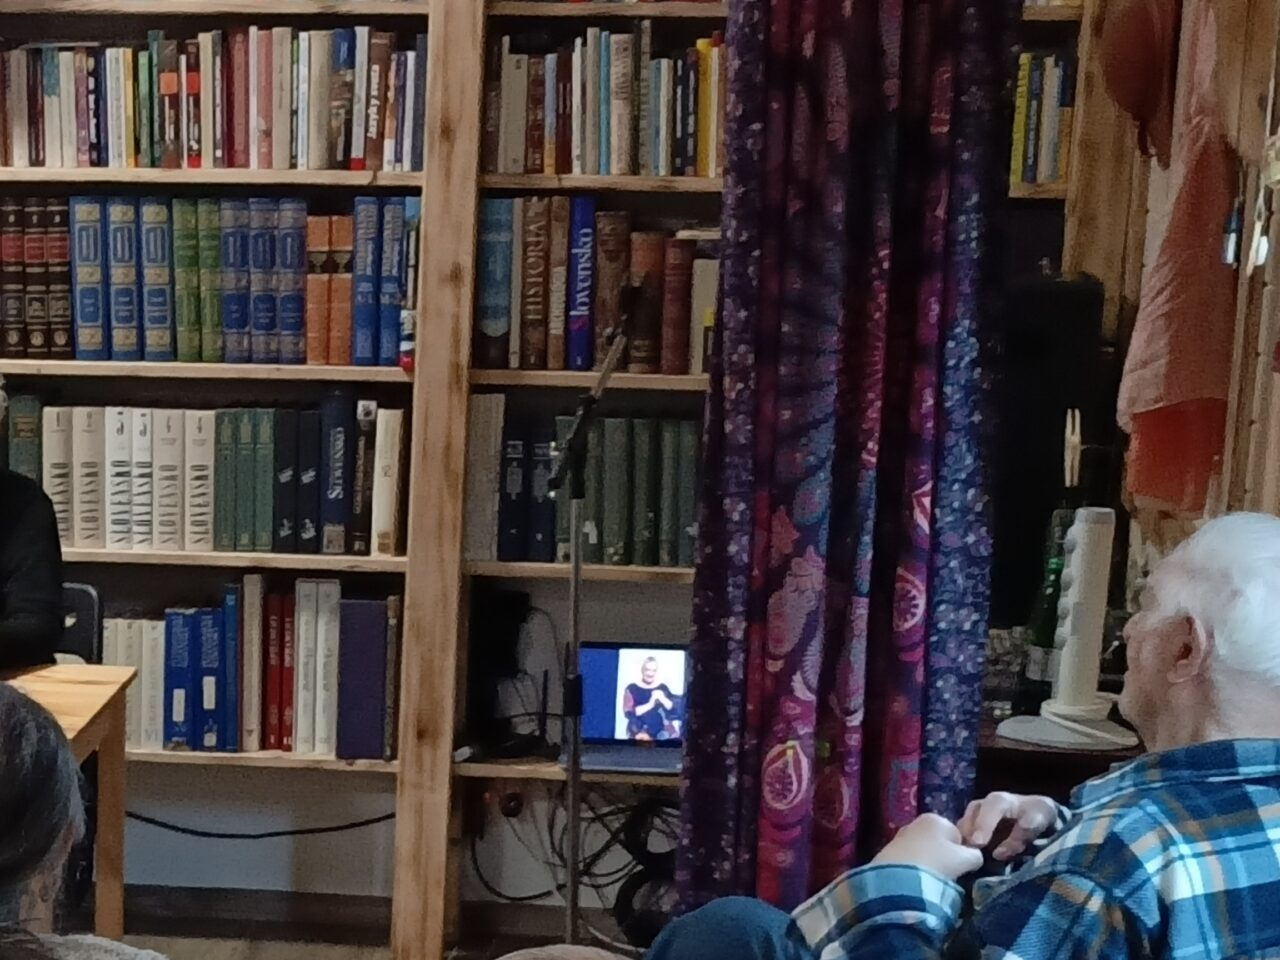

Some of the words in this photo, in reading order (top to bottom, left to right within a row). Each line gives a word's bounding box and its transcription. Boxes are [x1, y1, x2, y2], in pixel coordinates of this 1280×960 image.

[523, 220, 547, 321] HISTORIA
[110, 460, 132, 545] SLOVENSKO
[189, 464, 210, 545] SLOVENSKO
